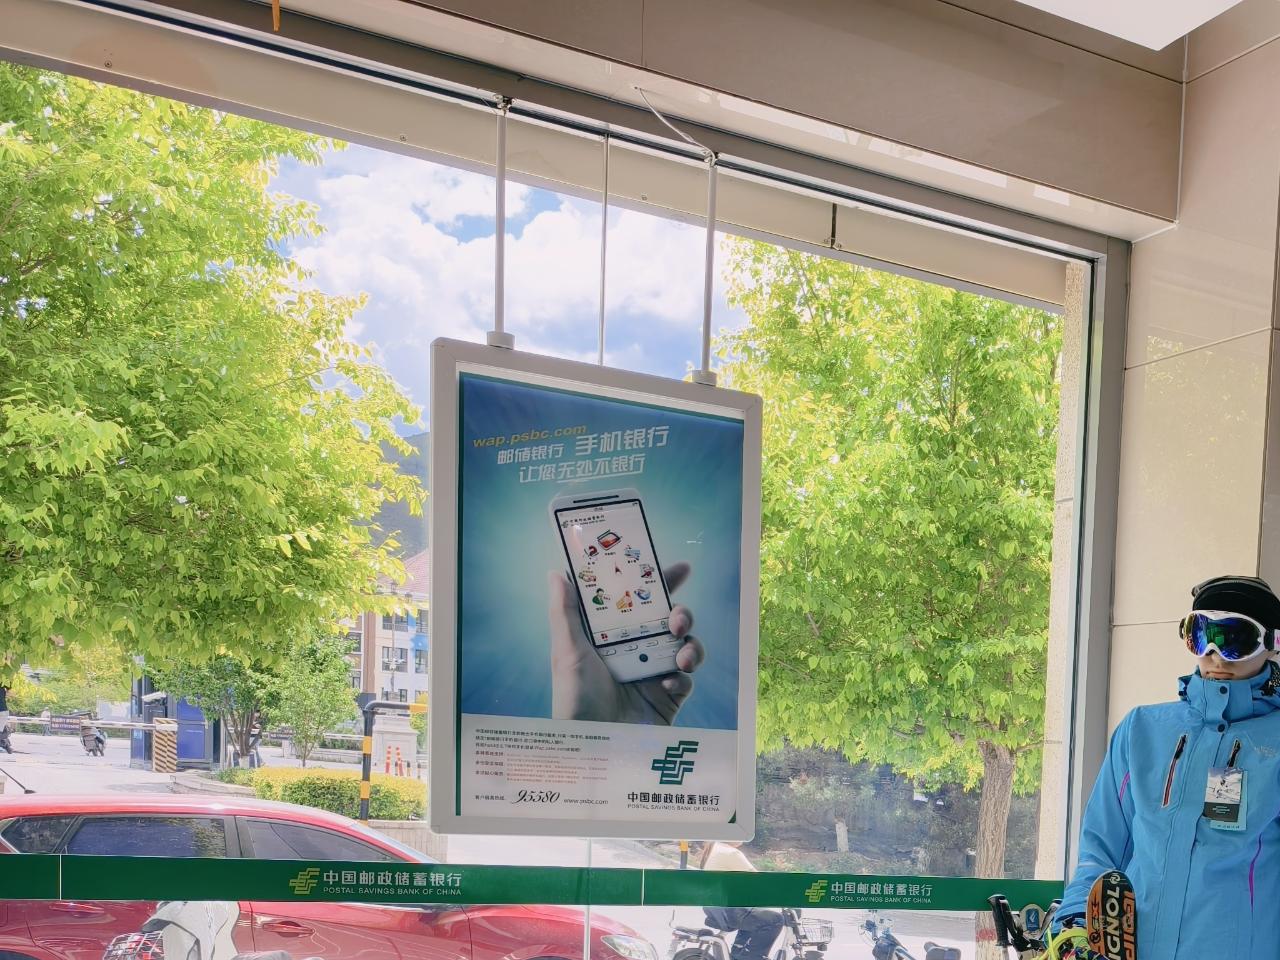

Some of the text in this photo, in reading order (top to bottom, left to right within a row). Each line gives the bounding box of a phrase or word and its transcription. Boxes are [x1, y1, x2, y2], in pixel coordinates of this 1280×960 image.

[473, 425, 588, 447] wap.psbc.com
[497, 425, 671, 465] 邮储银行 手机银行
[519, 453, 646, 483] 让您无处不银行
[511, 789, 561, 804] 95580
[627, 791, 721, 806] 中国邮政储蓄银行
[323, 869, 462, 887] 中国邮政储蓄银行
[358, 887, 394, 895] SAVINGS
[436, 888, 462, 896] CHINA
[831, 881, 933, 897] 中国邮政储蓄银行
